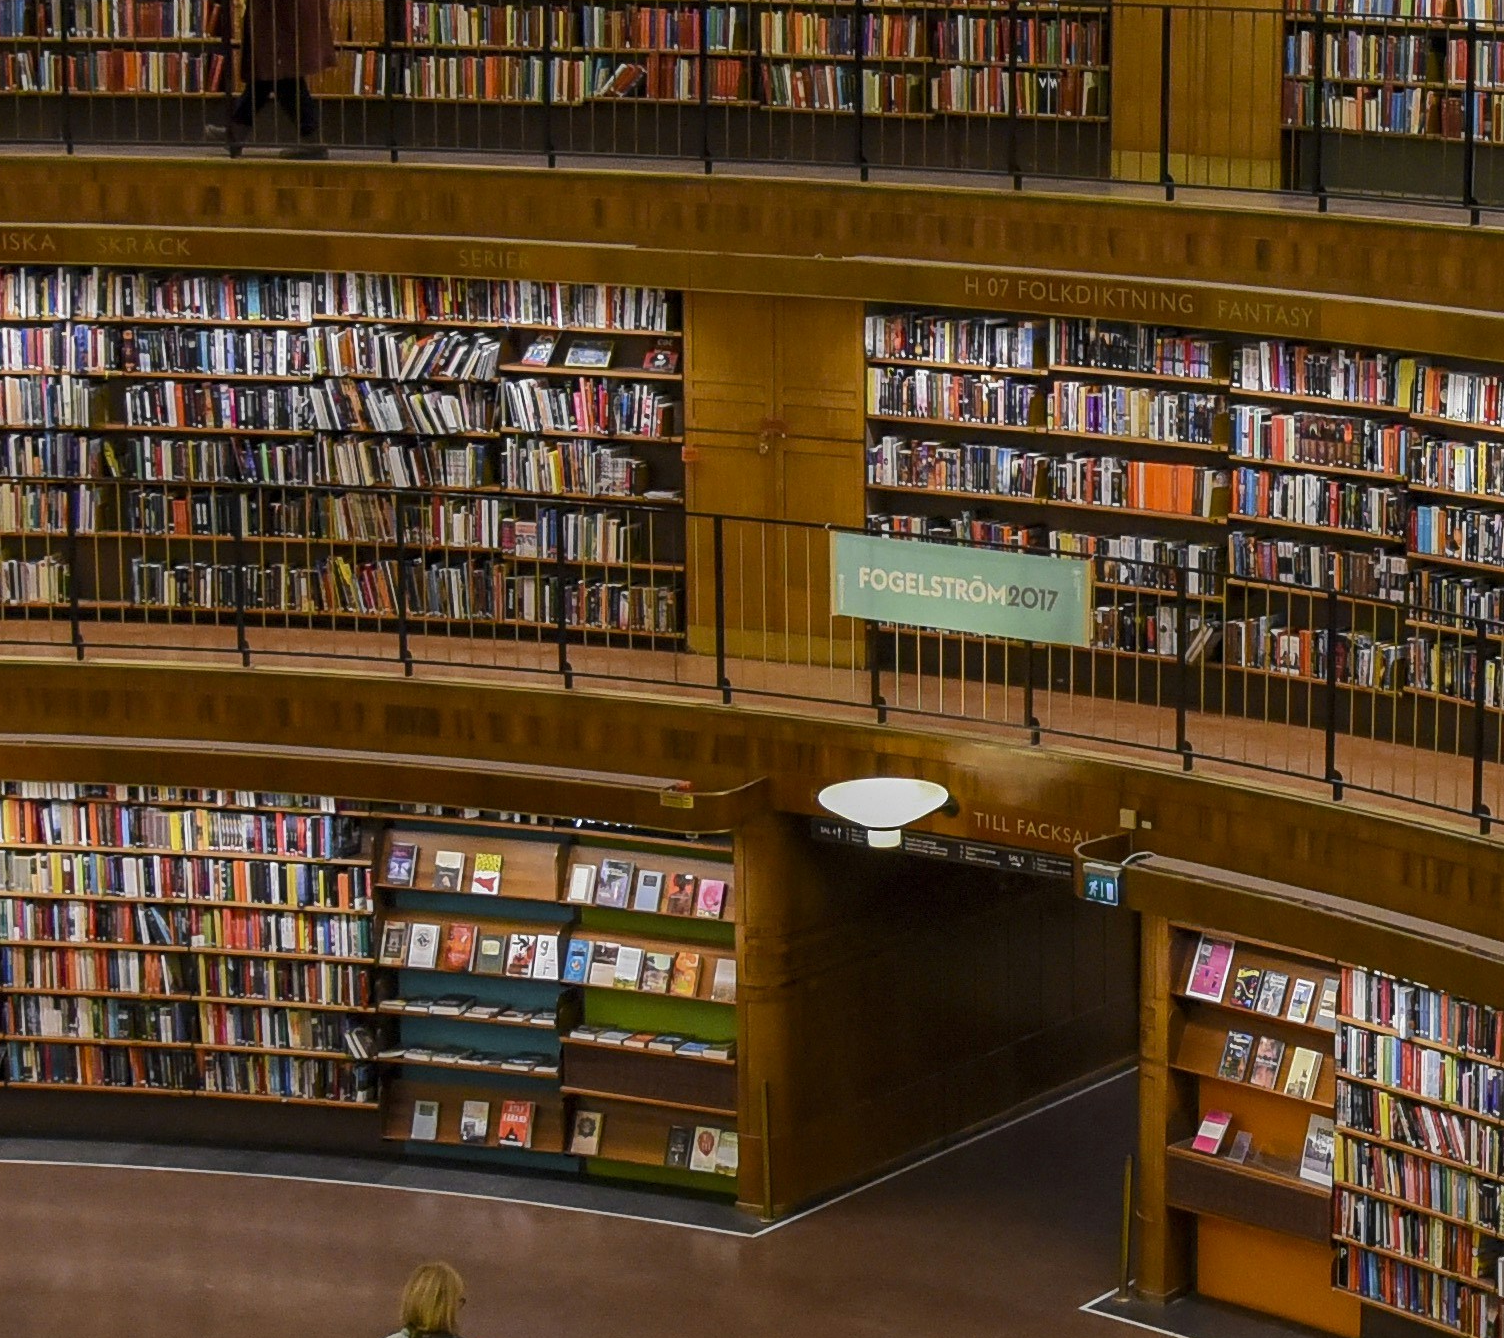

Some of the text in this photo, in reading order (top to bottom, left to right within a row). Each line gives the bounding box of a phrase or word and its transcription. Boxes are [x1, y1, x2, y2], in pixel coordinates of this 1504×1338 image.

[96, 234, 192, 257] SKRÄCK
[458, 248, 531, 270] SERIER
[964, 275, 979, 295] H
[1017, 279, 1194, 314] FOLKDIKTNING
[1217, 298, 1313, 329] FANTASY
[973, 811, 1010, 834] TILL
[1340, 1246, 1348, 1259] P
